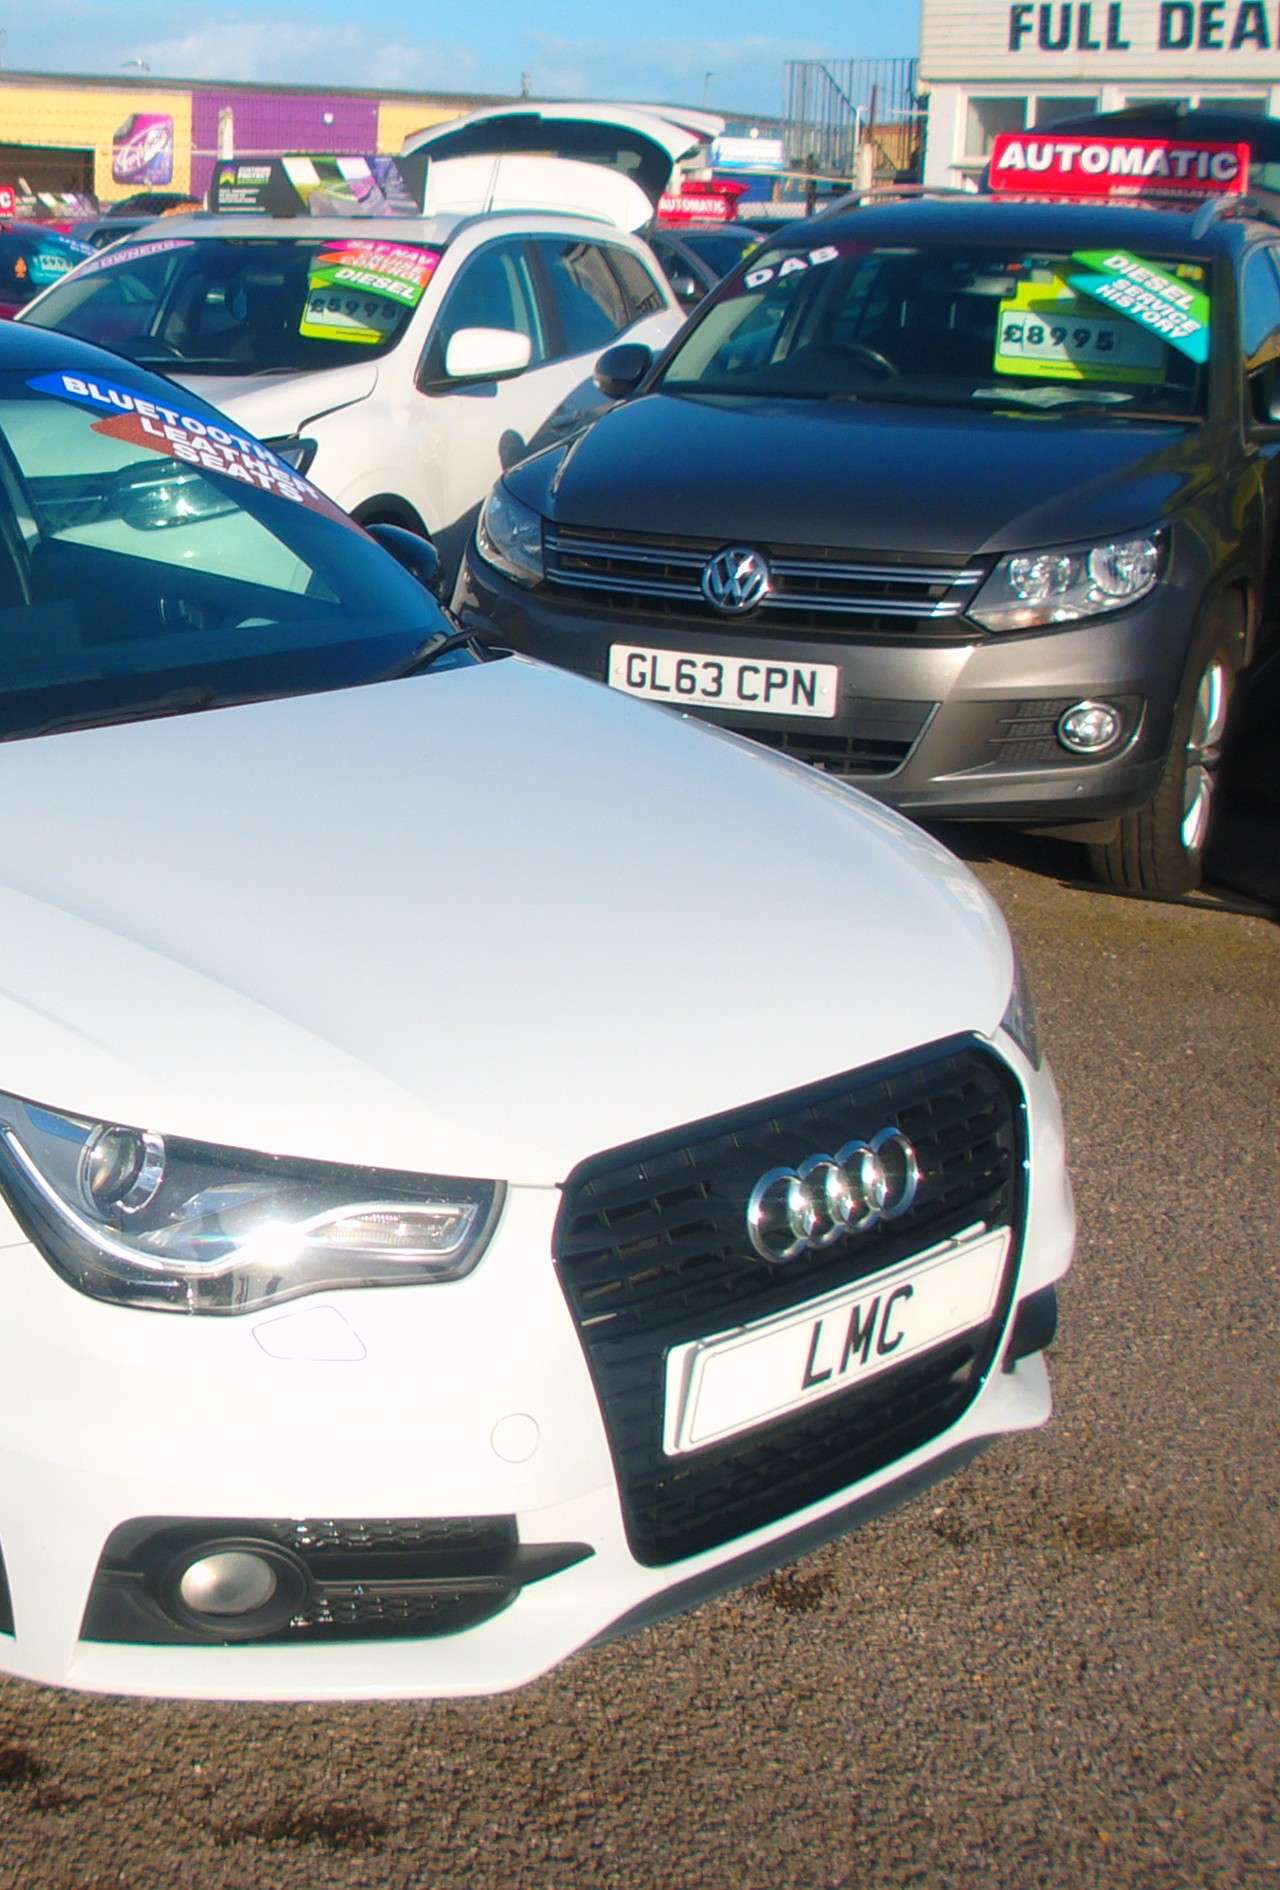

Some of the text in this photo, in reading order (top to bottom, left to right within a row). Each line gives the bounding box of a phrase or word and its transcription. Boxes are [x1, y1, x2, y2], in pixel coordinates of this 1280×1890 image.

[1009, 1, 1280, 51] FULL DEA
[998, 142, 1239, 181] AUTOMATIC
[658, 198, 726, 214] AUTOMATIC
[100, 239, 177, 269] OWNERS
[390, 248, 435, 266] NAV
[744, 245, 839, 289] DAB
[334, 268, 417, 299] DIESEL
[1103, 255, 1195, 311] DIESEL
[1111, 278, 1201, 333] SERVICE
[1003, 322, 1115, 352] £8995
[1095, 283, 1191, 340] HISTORY
[61, 375, 278, 467] BLUETOOTH
[139, 416, 320, 500] LEATHER
[171, 442, 304, 503] SEATS
[626, 652, 817, 707] GL63 CPN
[801, 1283, 914, 1391] LMC
